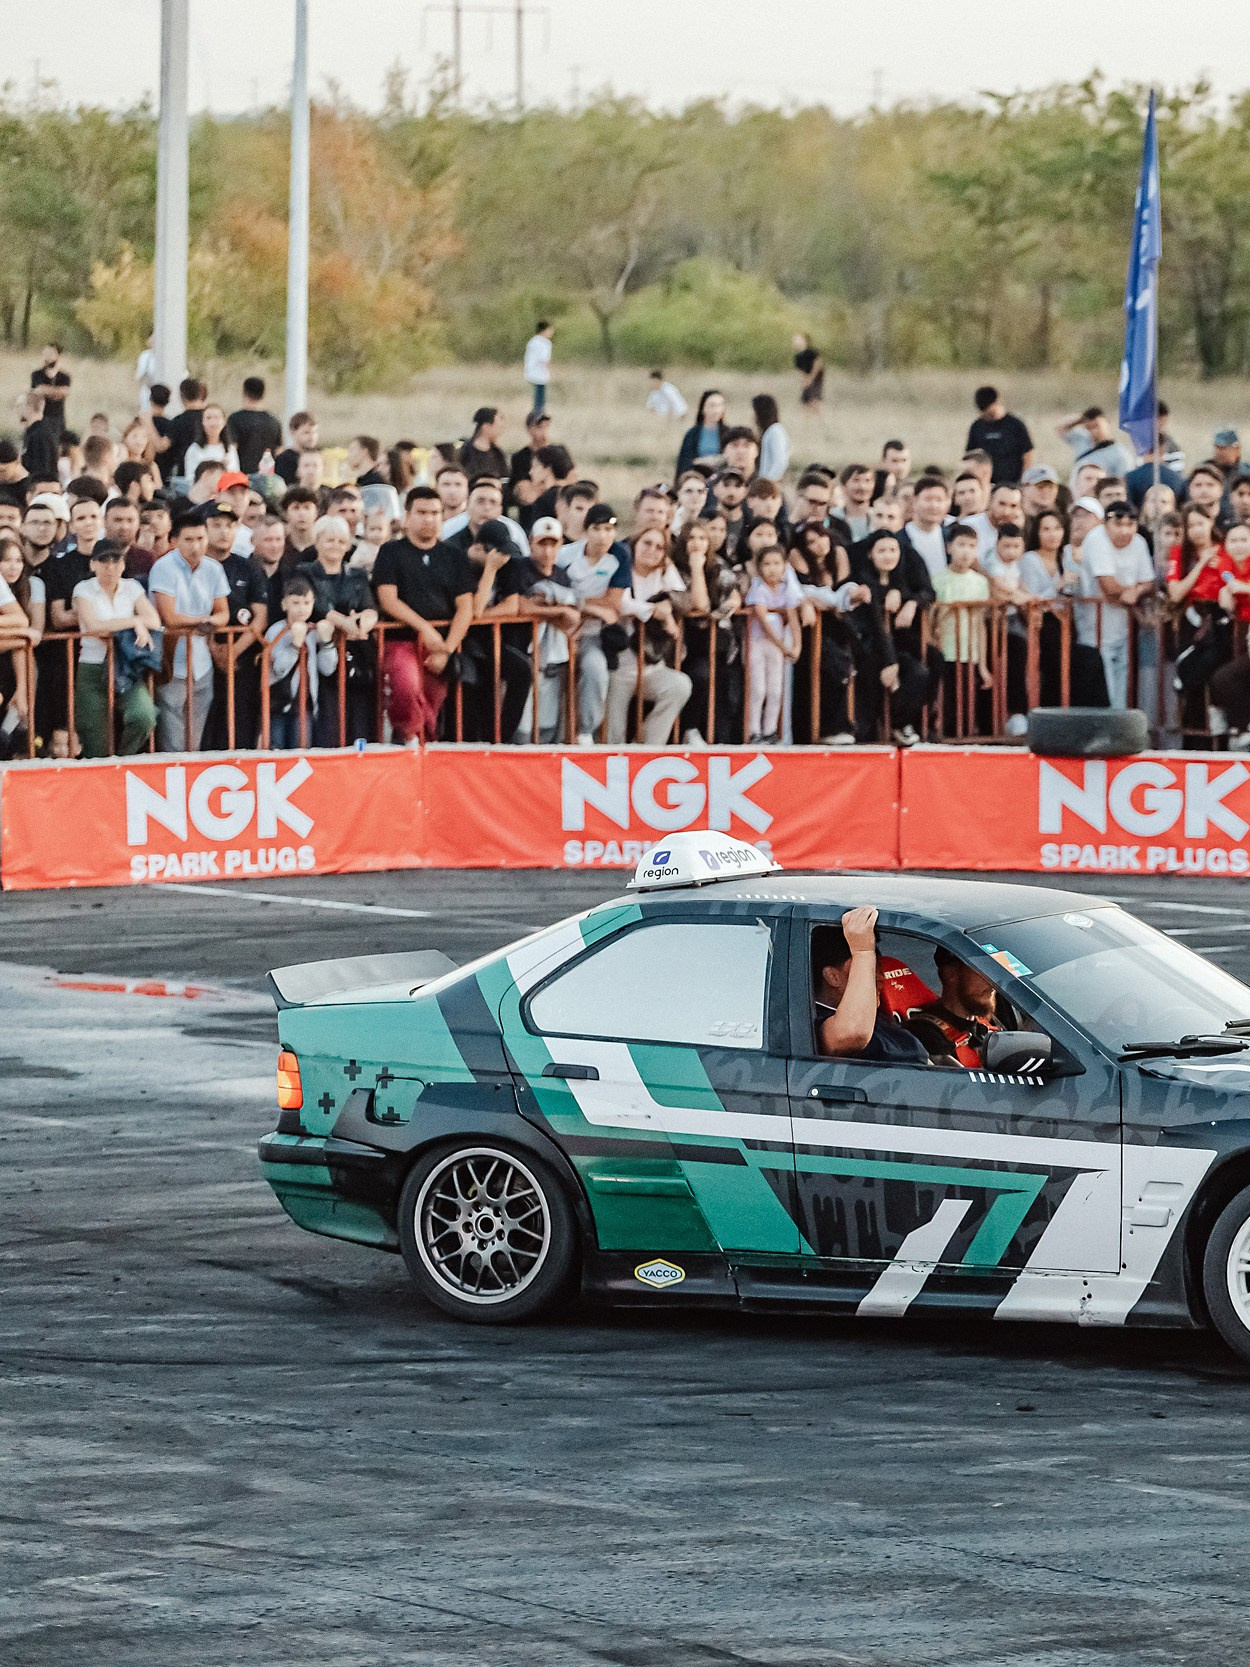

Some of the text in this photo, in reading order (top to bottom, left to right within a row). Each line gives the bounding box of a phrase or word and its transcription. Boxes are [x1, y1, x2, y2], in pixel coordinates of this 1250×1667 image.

[126, 757, 315, 846] NGK
[562, 755, 774, 834] NGK
[1039, 761, 1250, 842] NGK
[129, 845, 317, 880] SPARK PLUGS
[643, 867, 680, 880] region
[714, 847, 757, 868] region
[1040, 843, 1250, 874] SPARK PLUGS
[643, 1269, 678, 1278] YACCO
